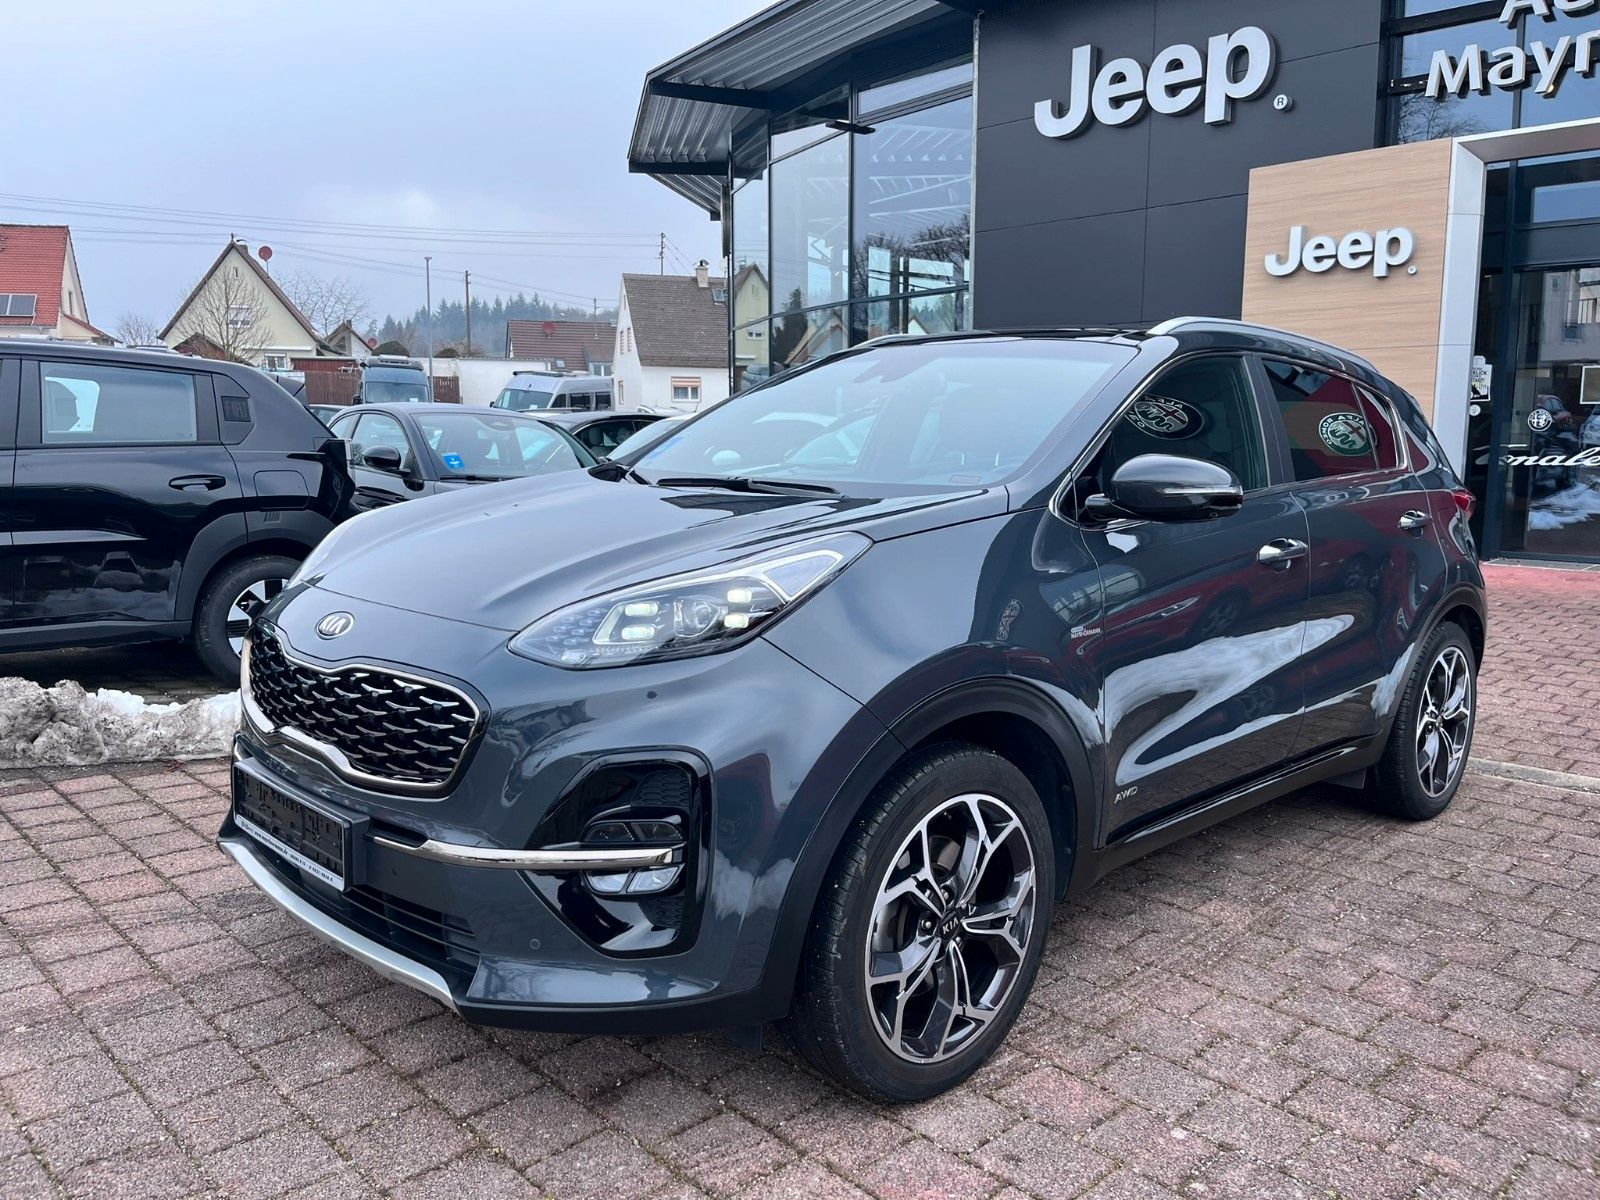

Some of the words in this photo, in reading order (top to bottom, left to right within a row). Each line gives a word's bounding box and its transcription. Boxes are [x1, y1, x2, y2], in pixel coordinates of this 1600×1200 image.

[1034, 26, 1274, 138] Jeep
[1264, 225, 1415, 278] Jeep
[318, 614, 347, 634] KIA
[1113, 786, 1139, 804] AWD
[942, 916, 959, 935] KIA
